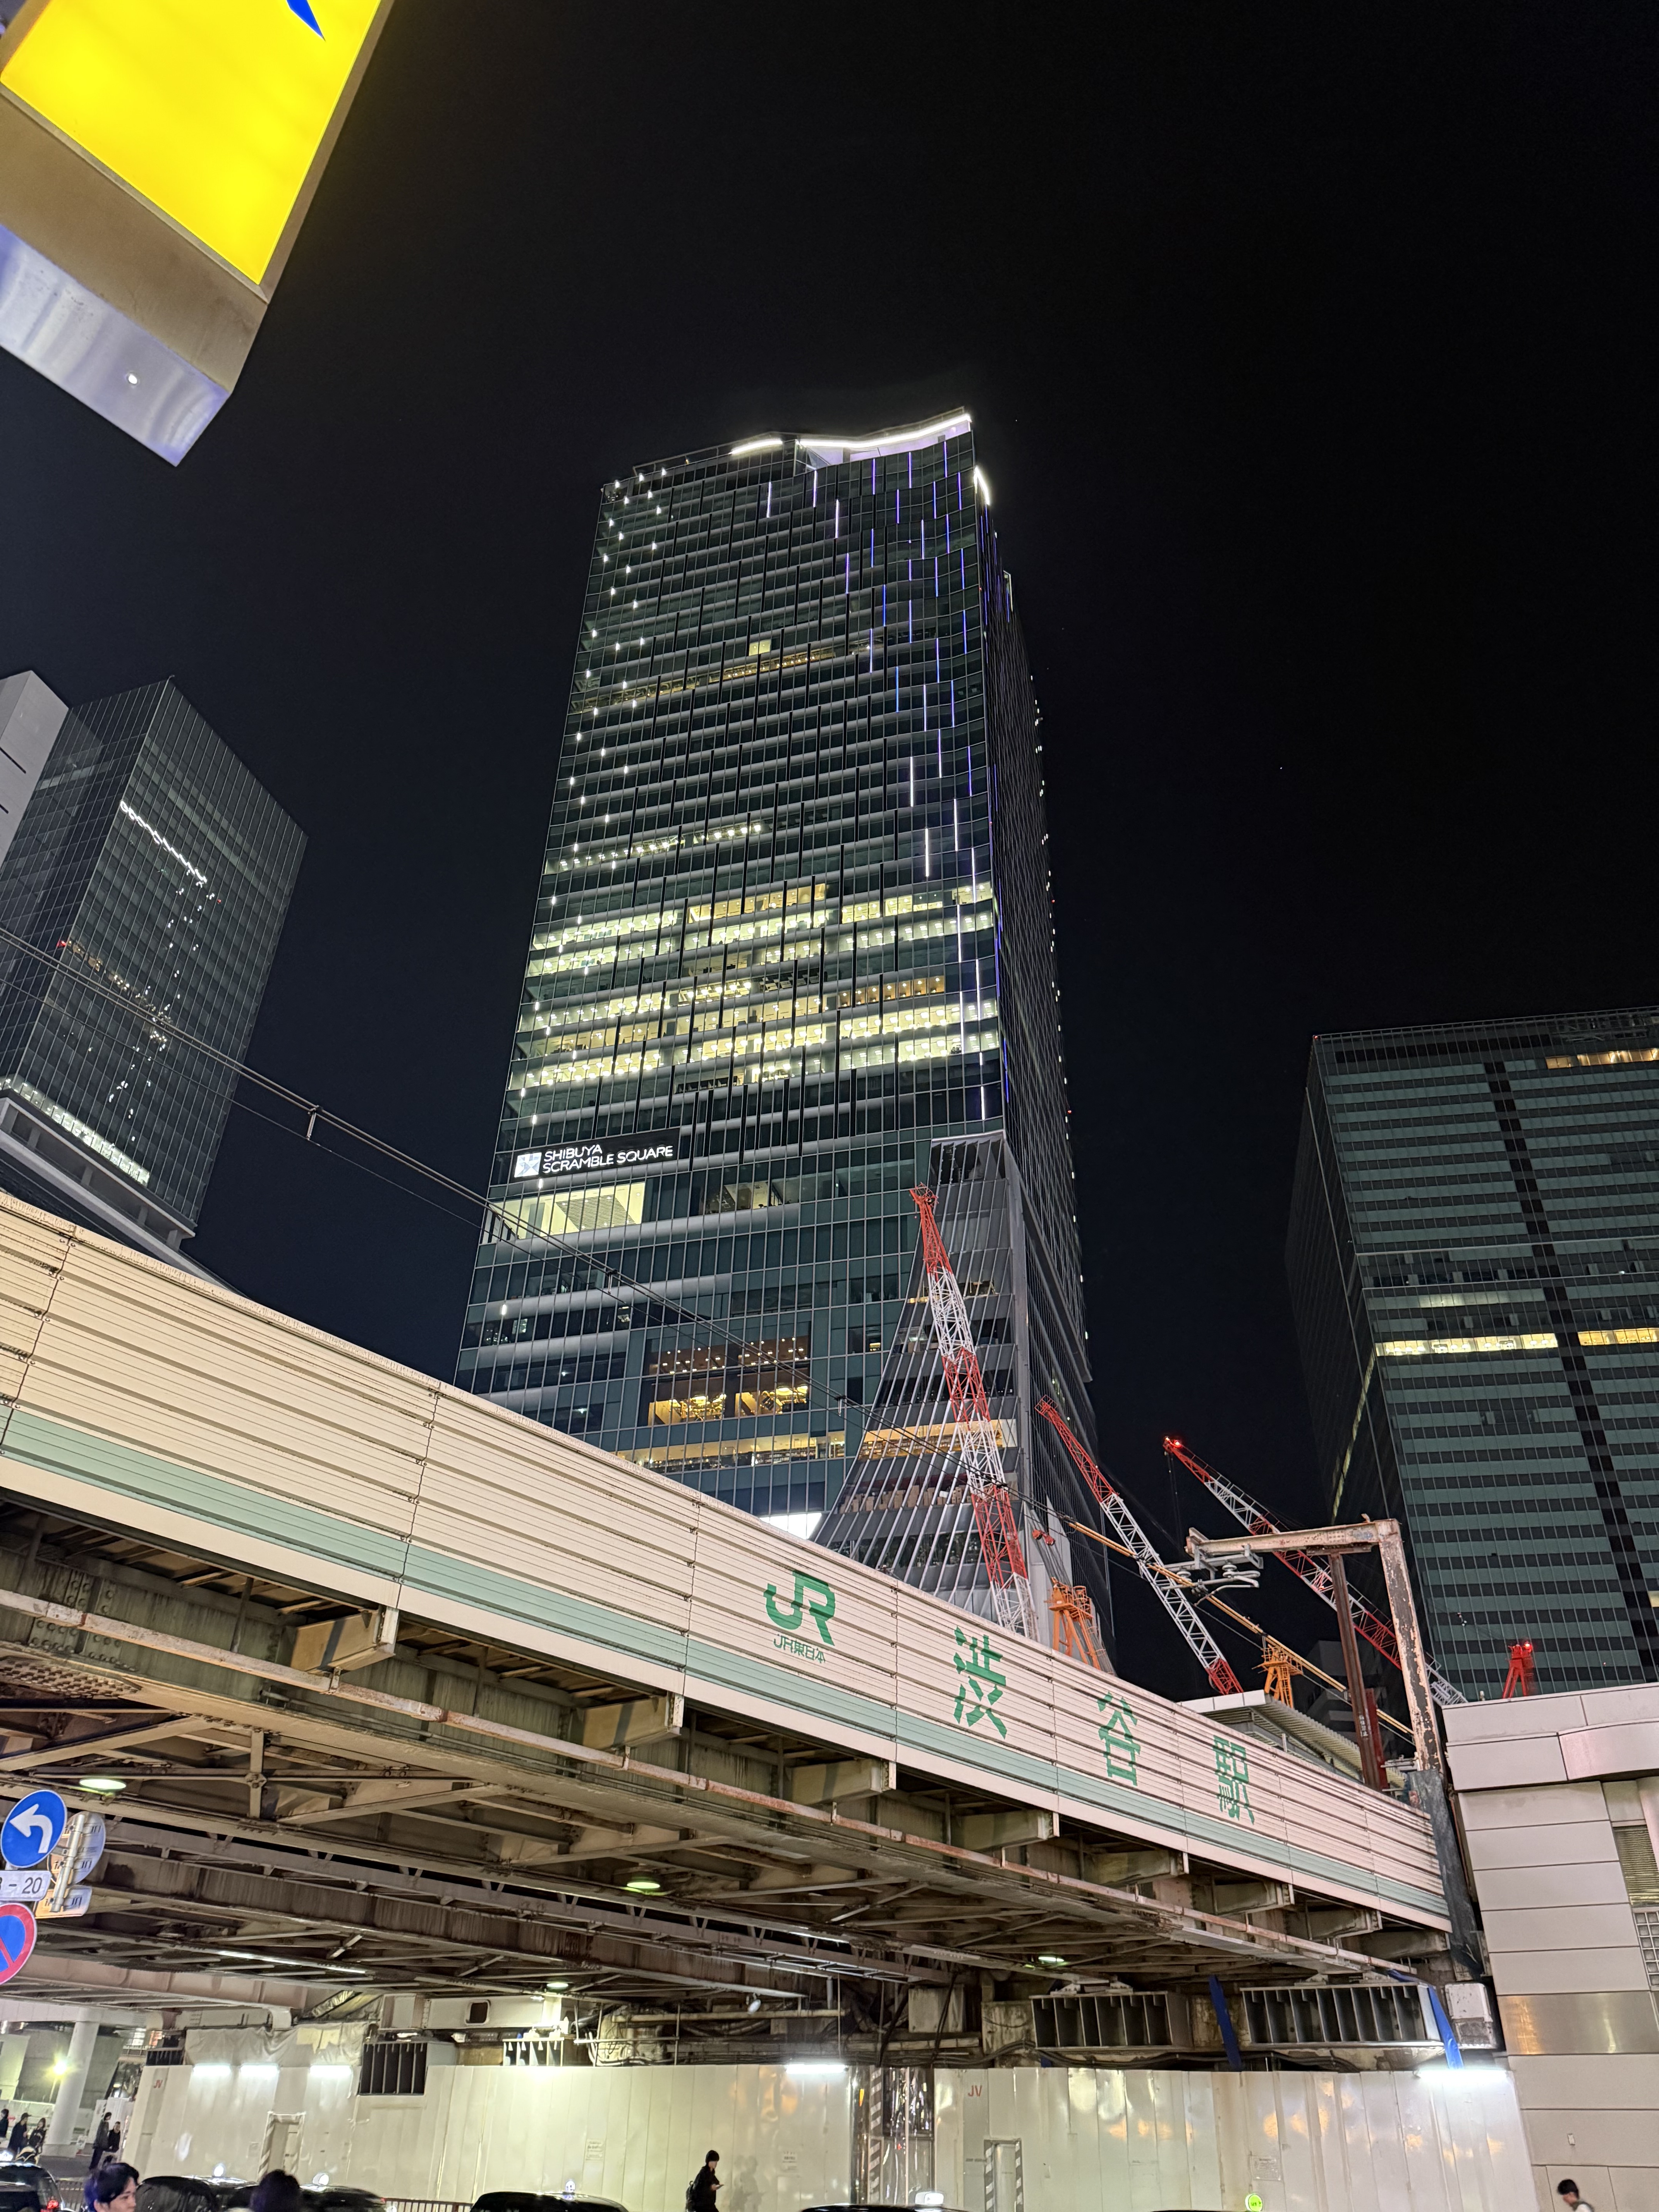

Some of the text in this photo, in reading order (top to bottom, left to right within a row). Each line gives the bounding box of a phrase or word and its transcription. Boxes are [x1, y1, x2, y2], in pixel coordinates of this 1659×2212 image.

[543, 1146, 673, 1174] SCRAMBLE SQUARE
[544, 1144, 603, 1162] SHIBUYA
[763, 1570, 835, 1646] JR
[953, 1626, 1255, 1825] 渋谷駅
[968, 2085, 982, 2097] JV
